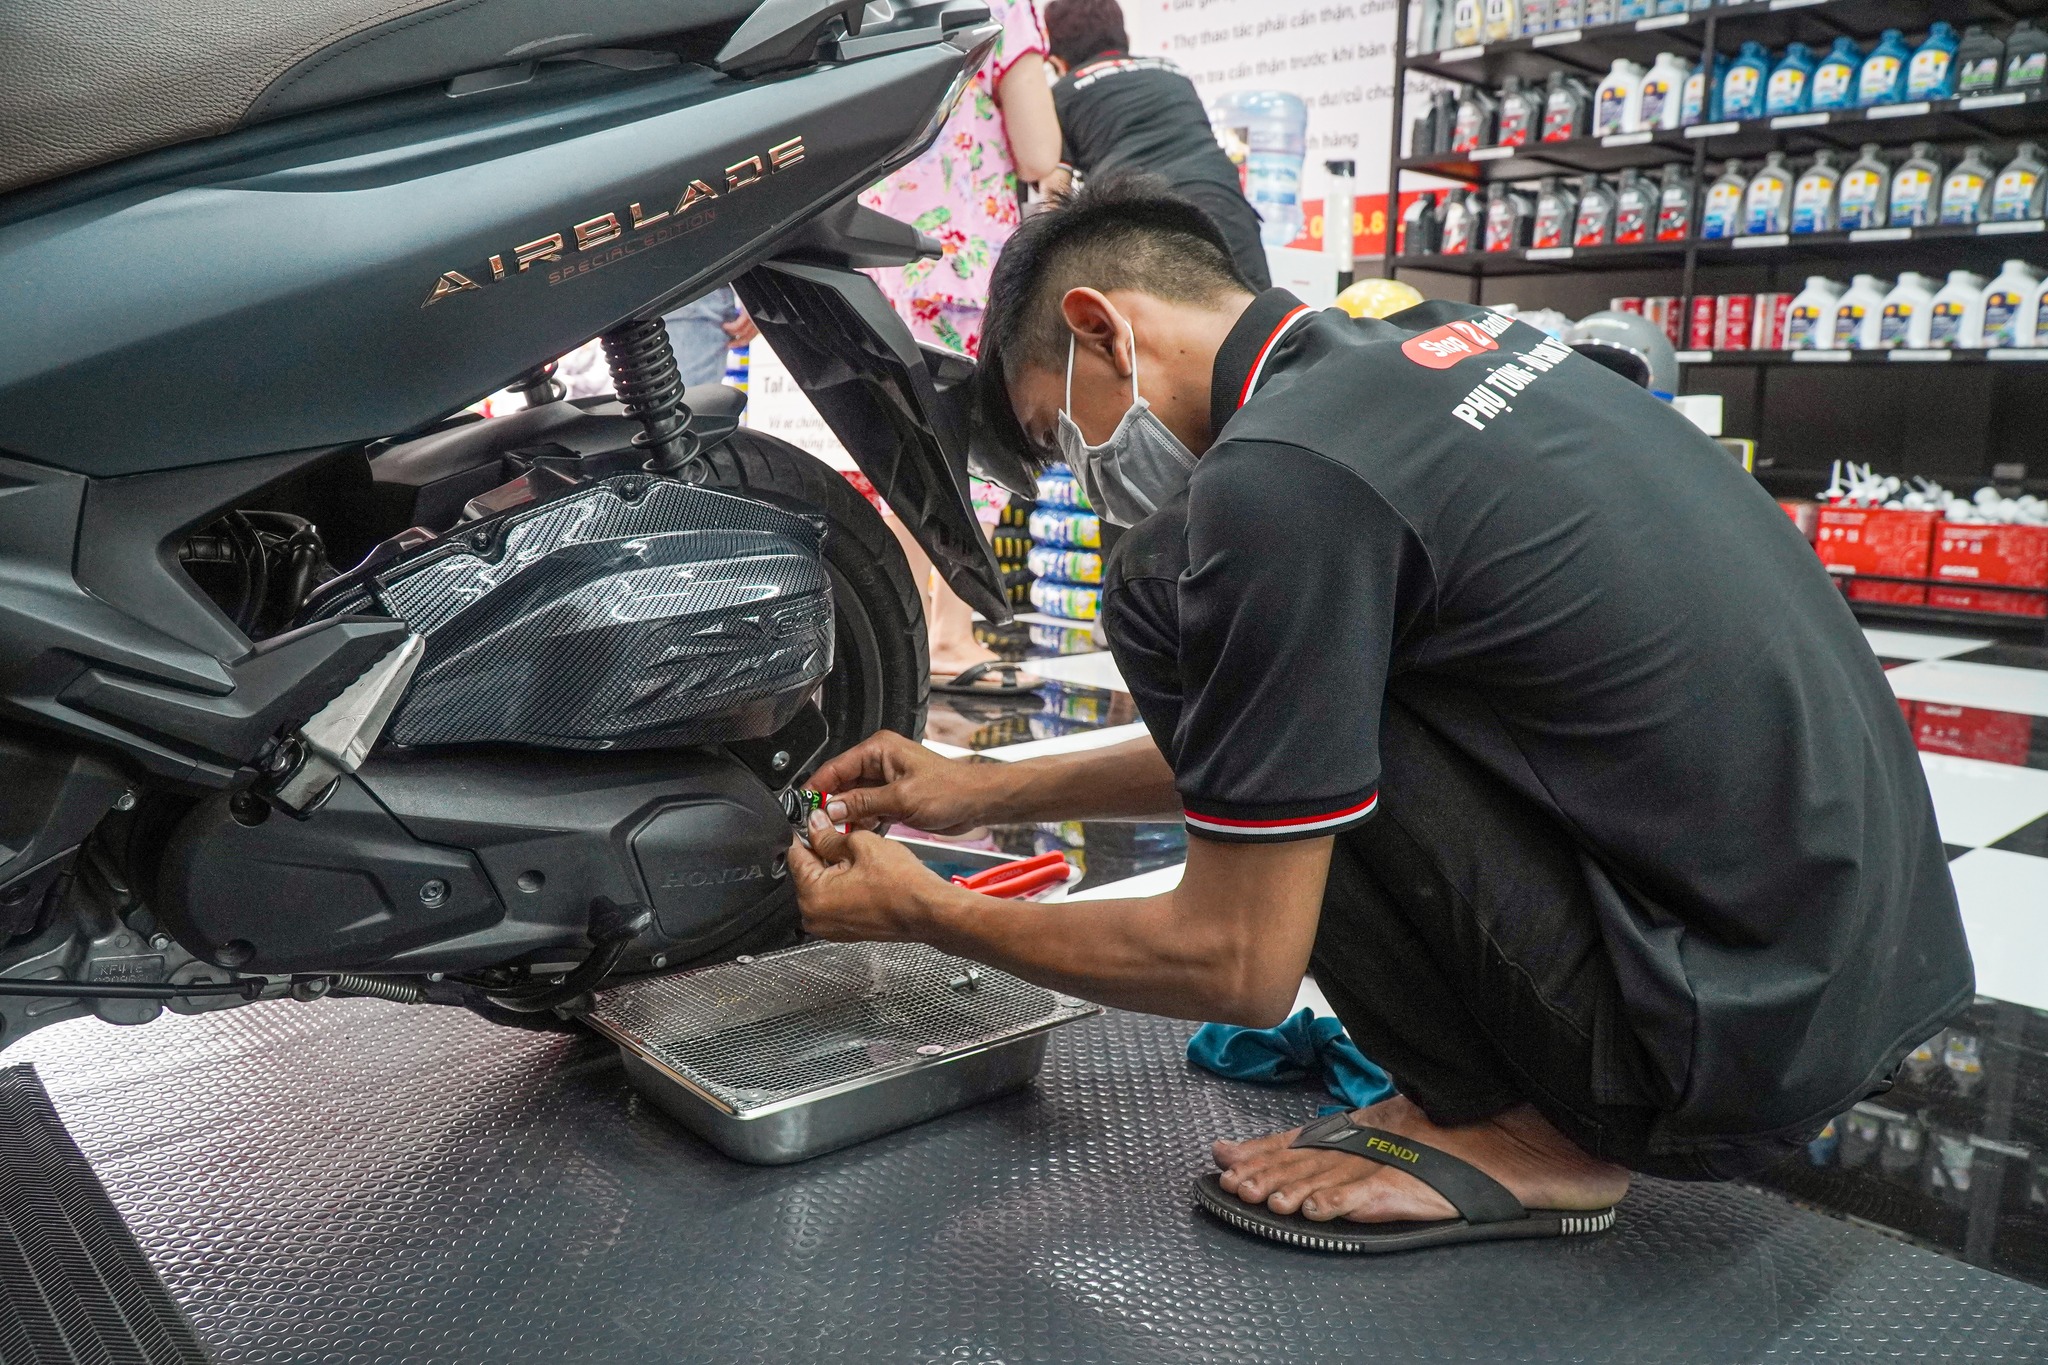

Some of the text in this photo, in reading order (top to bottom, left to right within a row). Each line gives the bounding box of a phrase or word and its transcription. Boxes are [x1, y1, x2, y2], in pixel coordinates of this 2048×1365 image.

[548, 209, 717, 285] SPECIAL EDITION
[1451, 384, 1513, 431] PHỤ
[1485, 363, 1538, 397] TÙNG
[1366, 1137, 1420, 1164] FENDI
